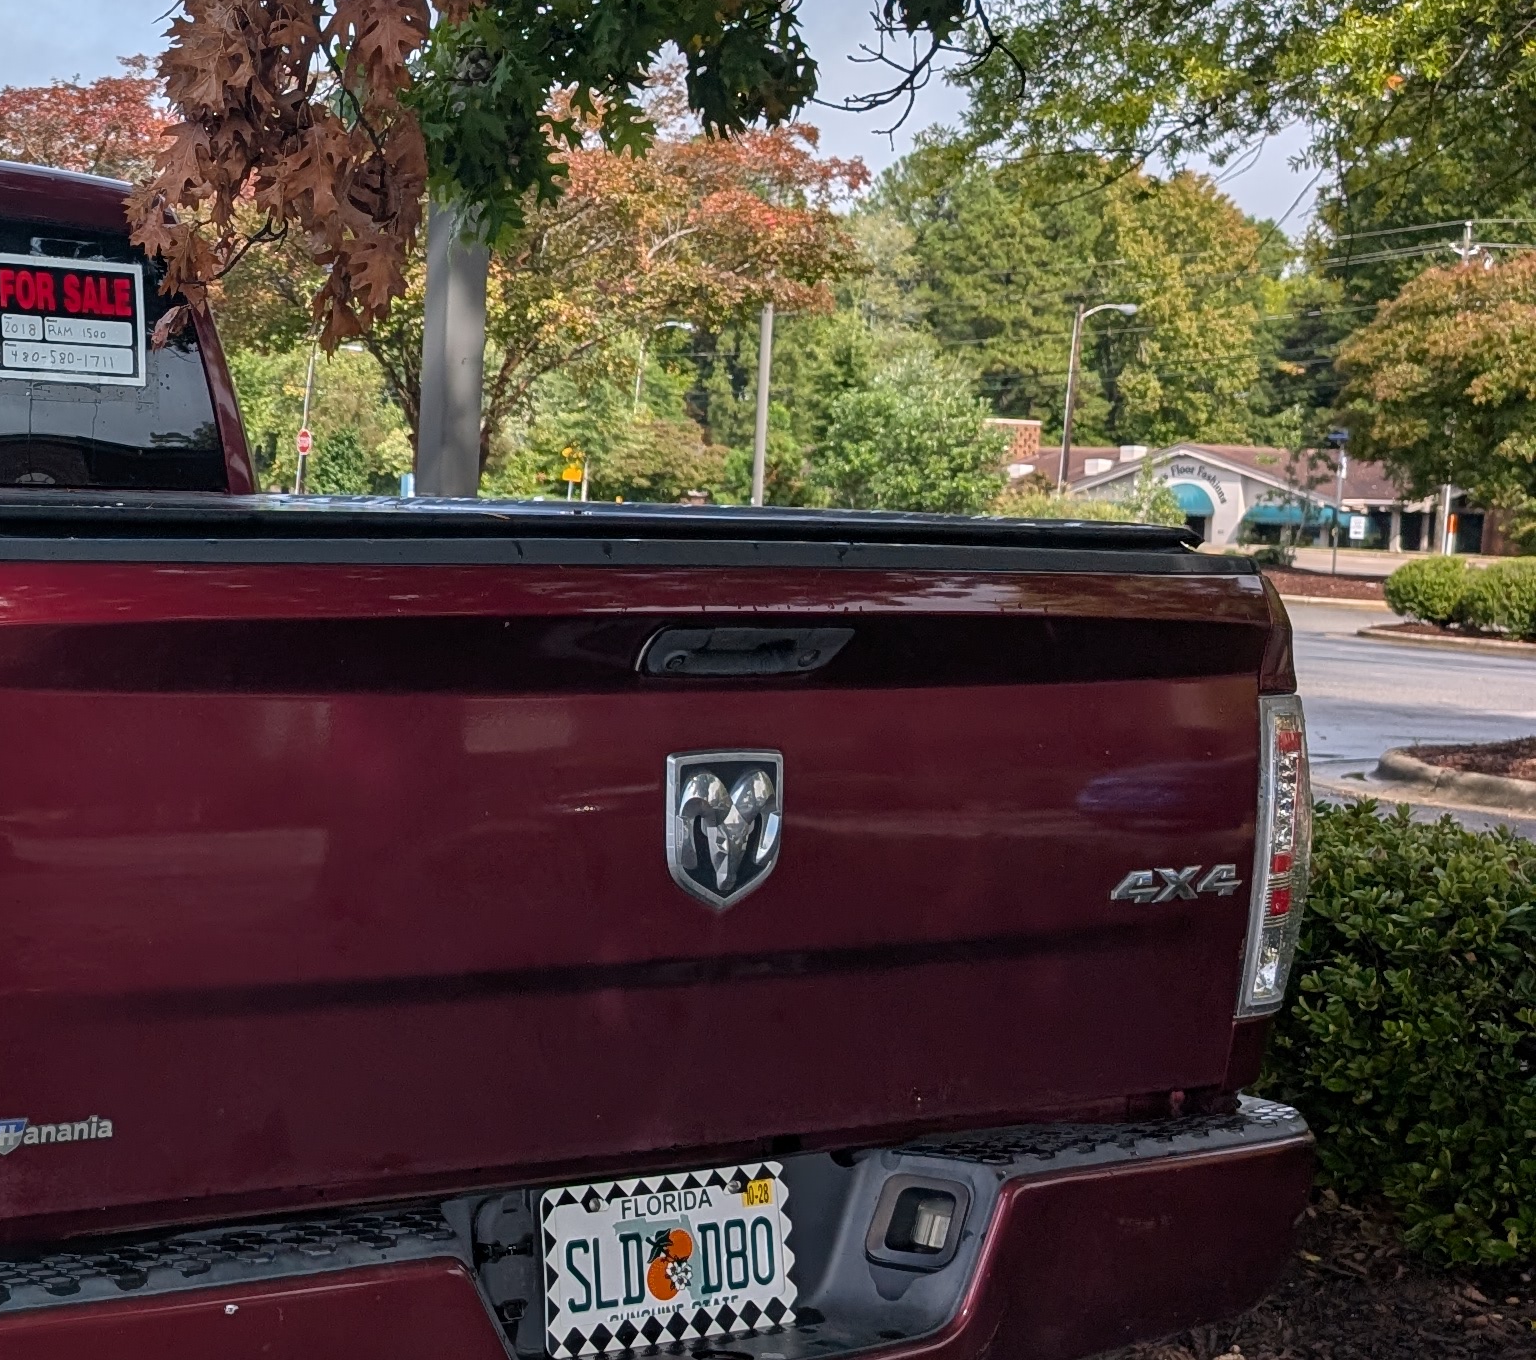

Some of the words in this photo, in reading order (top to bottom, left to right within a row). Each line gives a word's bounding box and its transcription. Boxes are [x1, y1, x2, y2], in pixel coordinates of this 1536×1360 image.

[0, 269, 56, 311] FOR
[64, 274, 132, 316] SALE
[4, 321, 37, 337] 2018
[47, 324, 73, 336] RAM
[82, 327, 107, 339] 1500
[11, 349, 114, 369] 480-580-1711
[1170, 464, 1195, 477] Floor
[620, 1188, 713, 1220] FLORIDA
[746, 1182, 770, 1206] 10-28
[565, 1231, 646, 1314] SLD
[697, 1215, 776, 1295] D80
